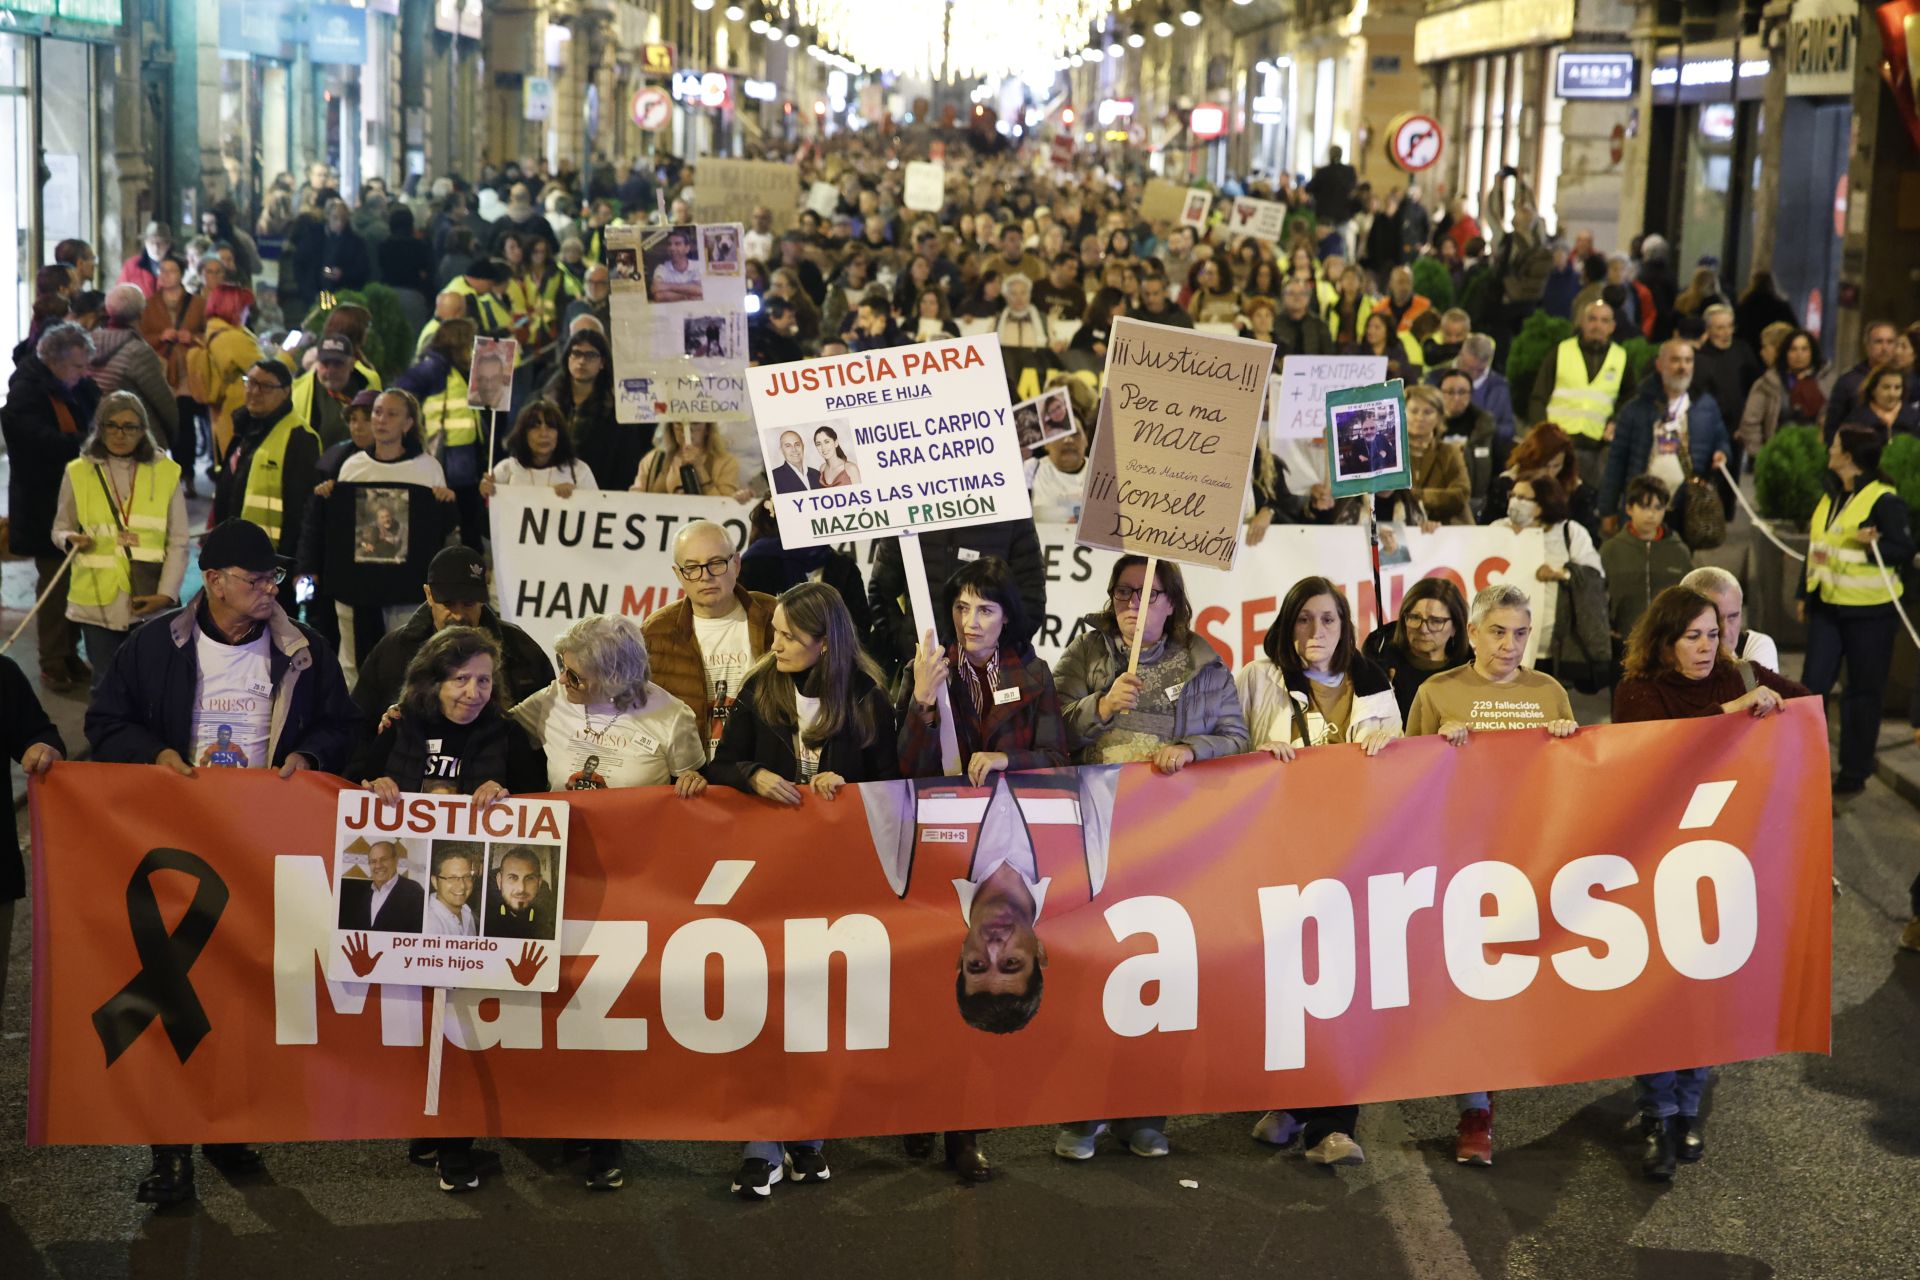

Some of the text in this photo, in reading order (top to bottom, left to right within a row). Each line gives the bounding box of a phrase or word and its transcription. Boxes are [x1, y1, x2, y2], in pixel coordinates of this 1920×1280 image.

[765, 344, 985, 397] JUSTICIA PARA
[1311, 363, 1376, 380] MENTIRAS
[826, 384, 932, 410] PADRE E HIJA
[1119, 383, 1159, 412] Per
[1165, 401, 1183, 417] a
[1190, 405, 1227, 422] ma
[855, 408, 1006, 445] MIGUEL CARPIO Y
[877, 437, 994, 468] SARA CARPIO
[1126, 459, 1158, 476] Rosa
[792, 472, 1005, 513] Y TODAS LAS VICTIMAS
[811, 494, 996, 535] MAZÓN PRISIÓN
[516, 579, 609, 619] HAN
[1470, 710, 1545, 719] 0 responsables
[1473, 701, 1540, 710] 229 fallecidos
[1509, 721, 1525, 730] NO
[214, 752, 234, 763] 228
[344, 796, 561, 840] JUSTICIA
[1102, 896, 1199, 1038] a
[1257, 780, 1759, 1071] presó
[392, 936, 498, 951] por mi marido
[404, 955, 484, 972] y mis hijos
